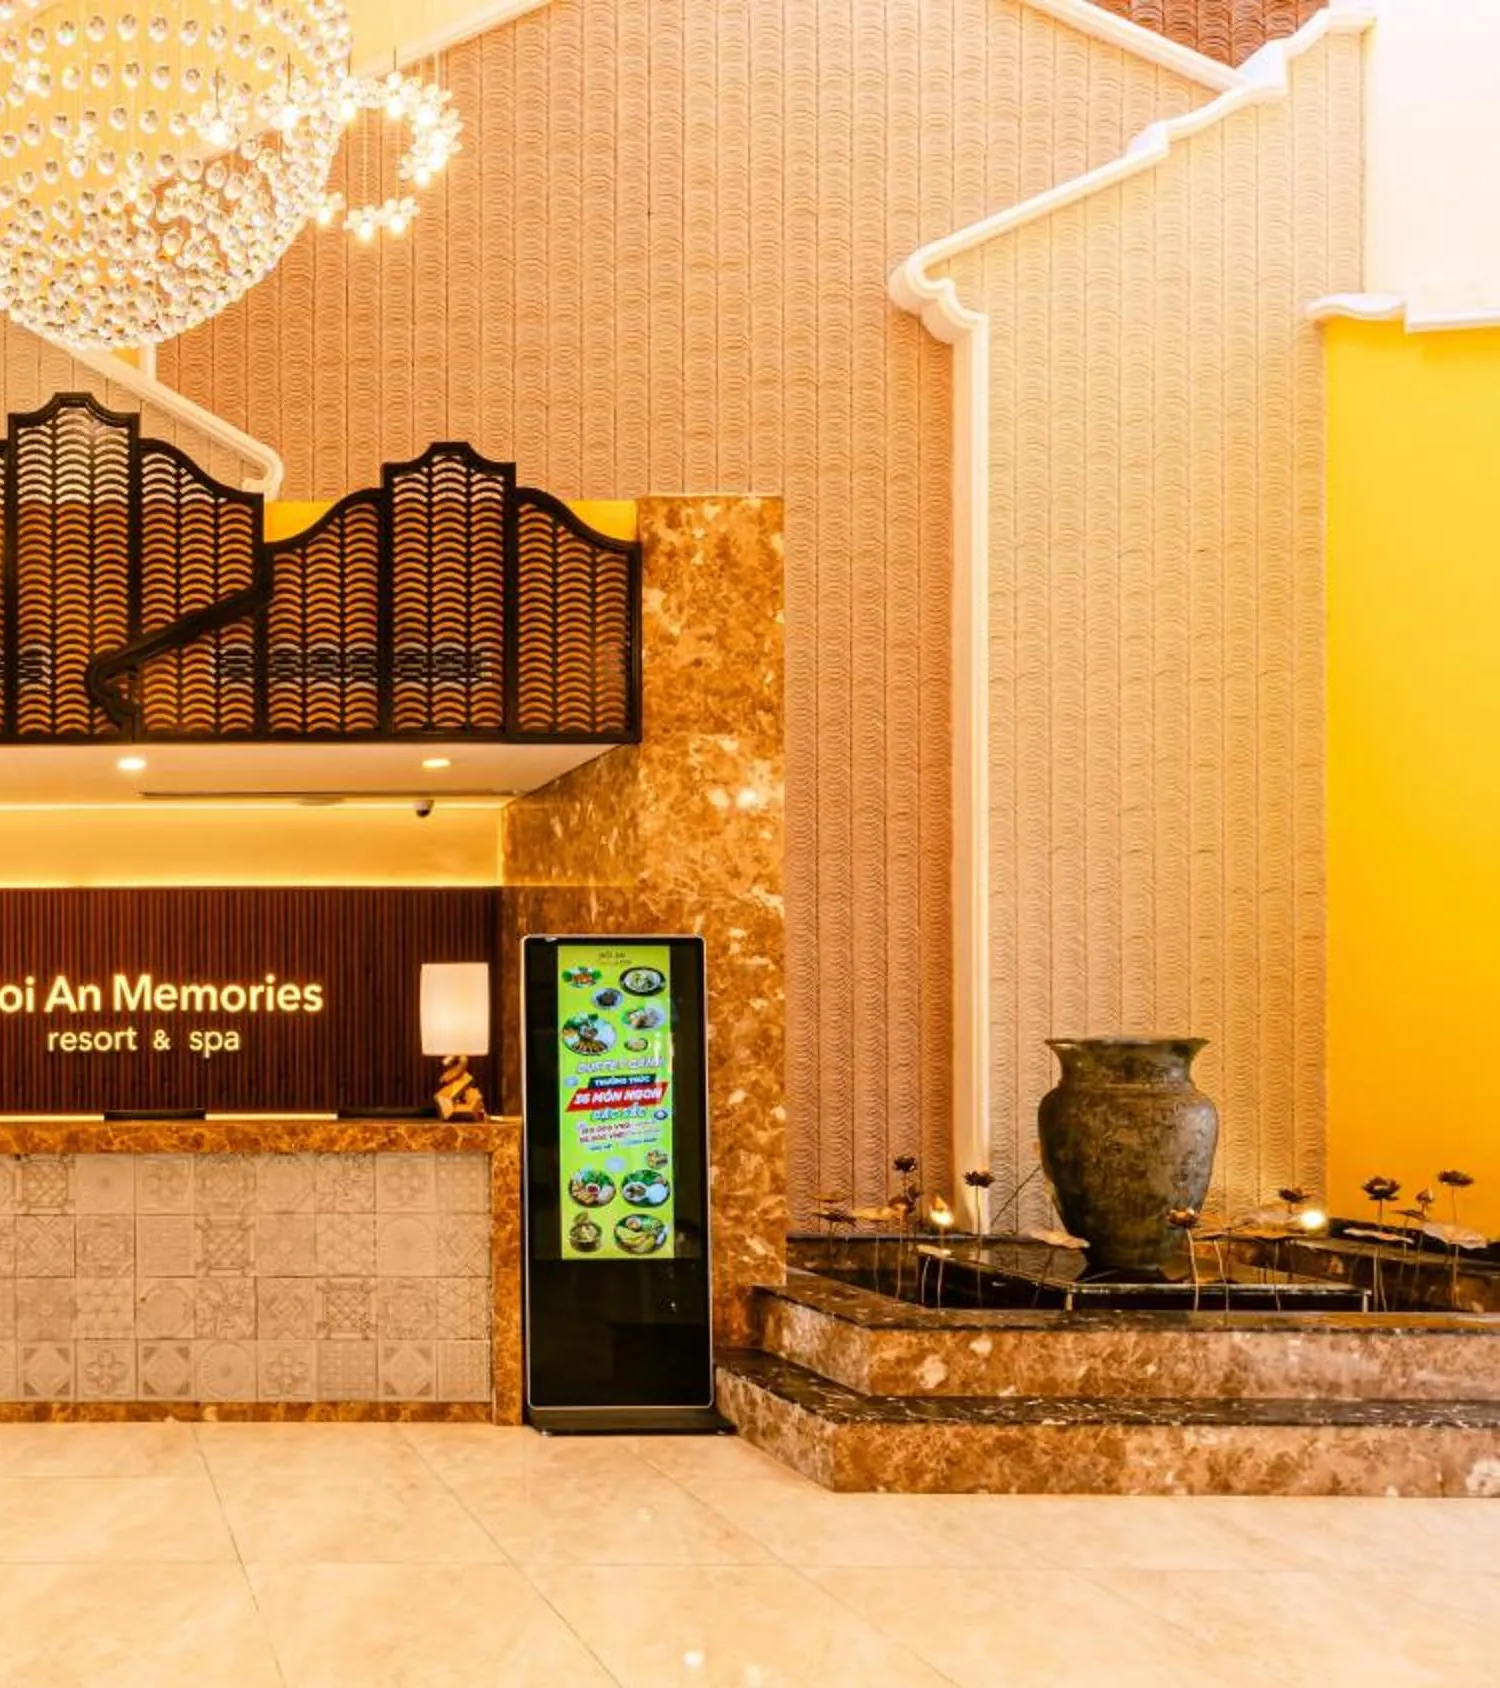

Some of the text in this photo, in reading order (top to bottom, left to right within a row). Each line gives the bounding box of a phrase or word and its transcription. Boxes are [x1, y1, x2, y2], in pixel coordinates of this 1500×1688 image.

[44, 975, 102, 1013] An
[113, 973, 323, 1013] Memories
[47, 1026, 241, 1059] resort & spa
